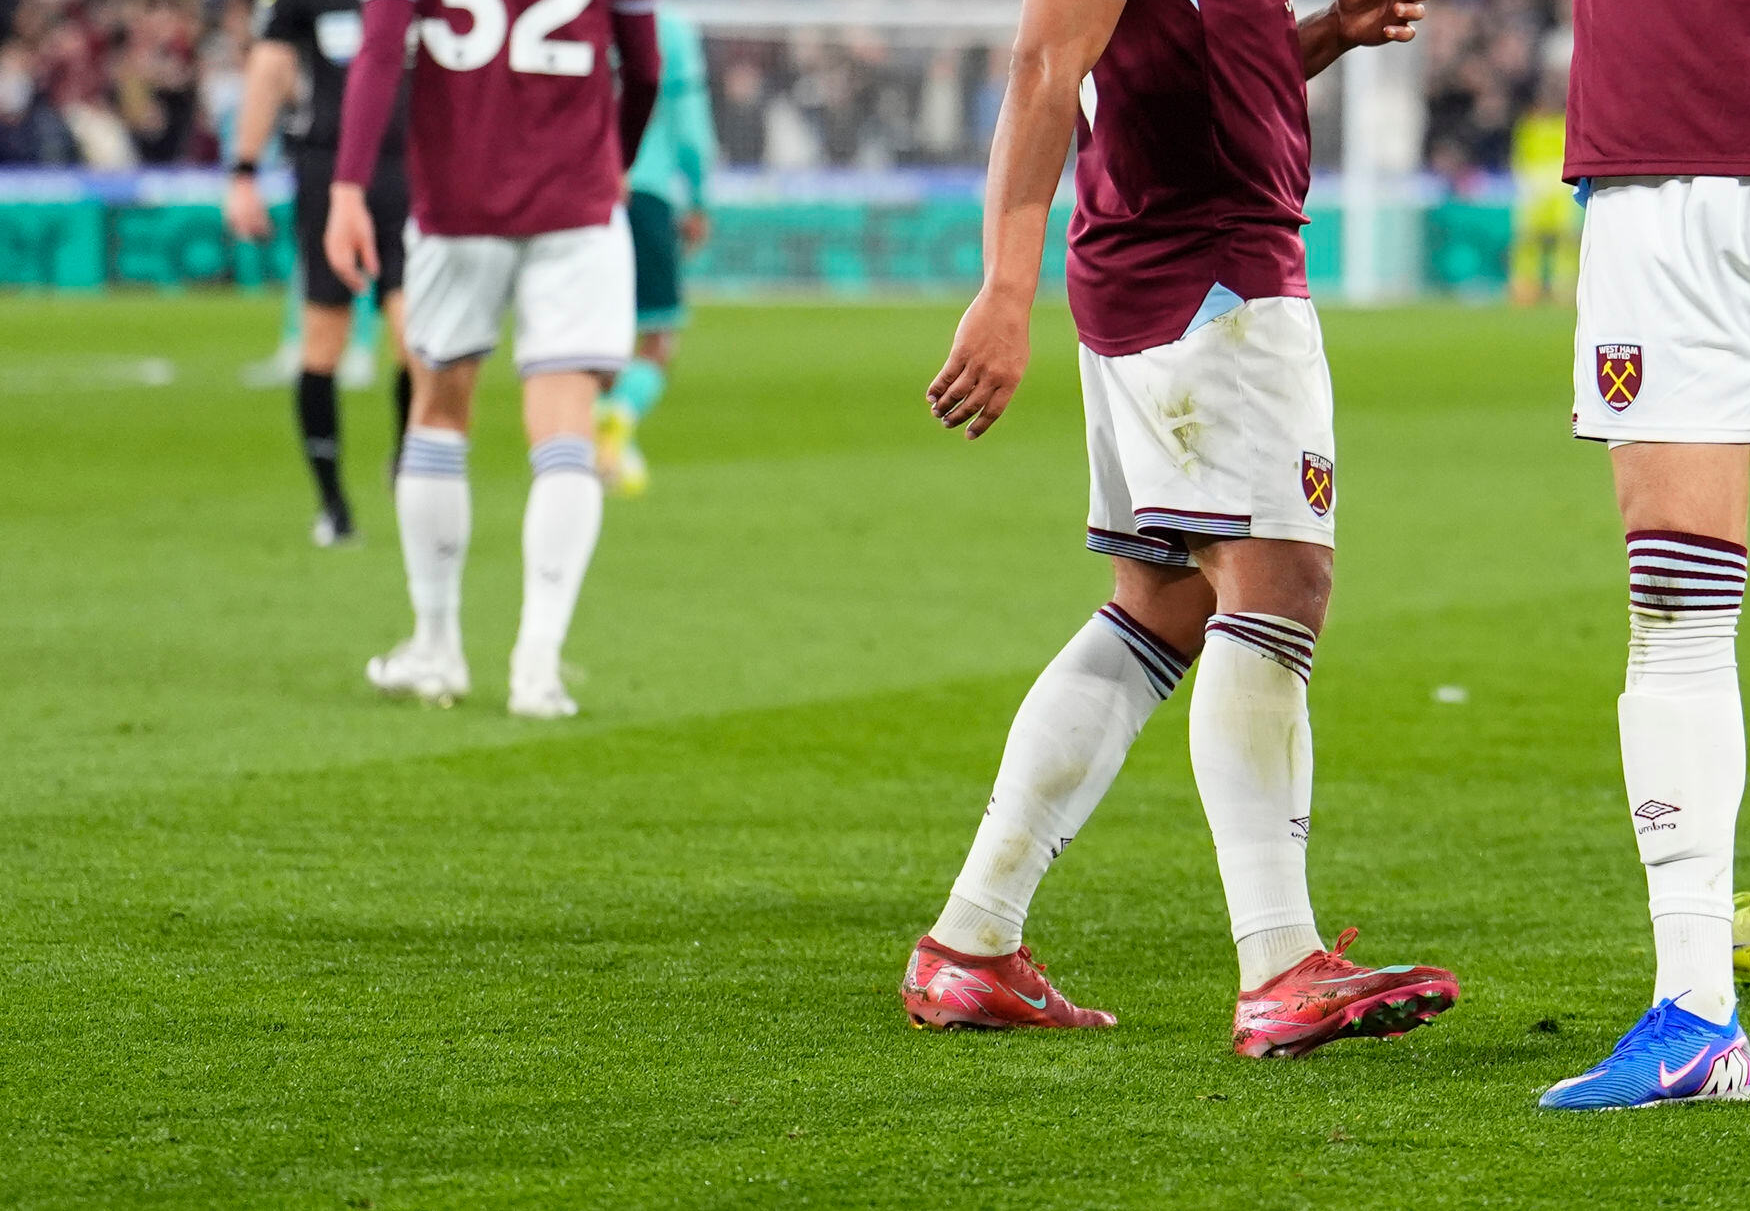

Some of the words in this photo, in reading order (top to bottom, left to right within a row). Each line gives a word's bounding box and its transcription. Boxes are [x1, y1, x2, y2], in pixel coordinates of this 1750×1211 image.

[1599, 345, 1619, 354] WEST
[1620, 345, 1639, 355] HAM
[1638, 821, 1677, 835] umbro
